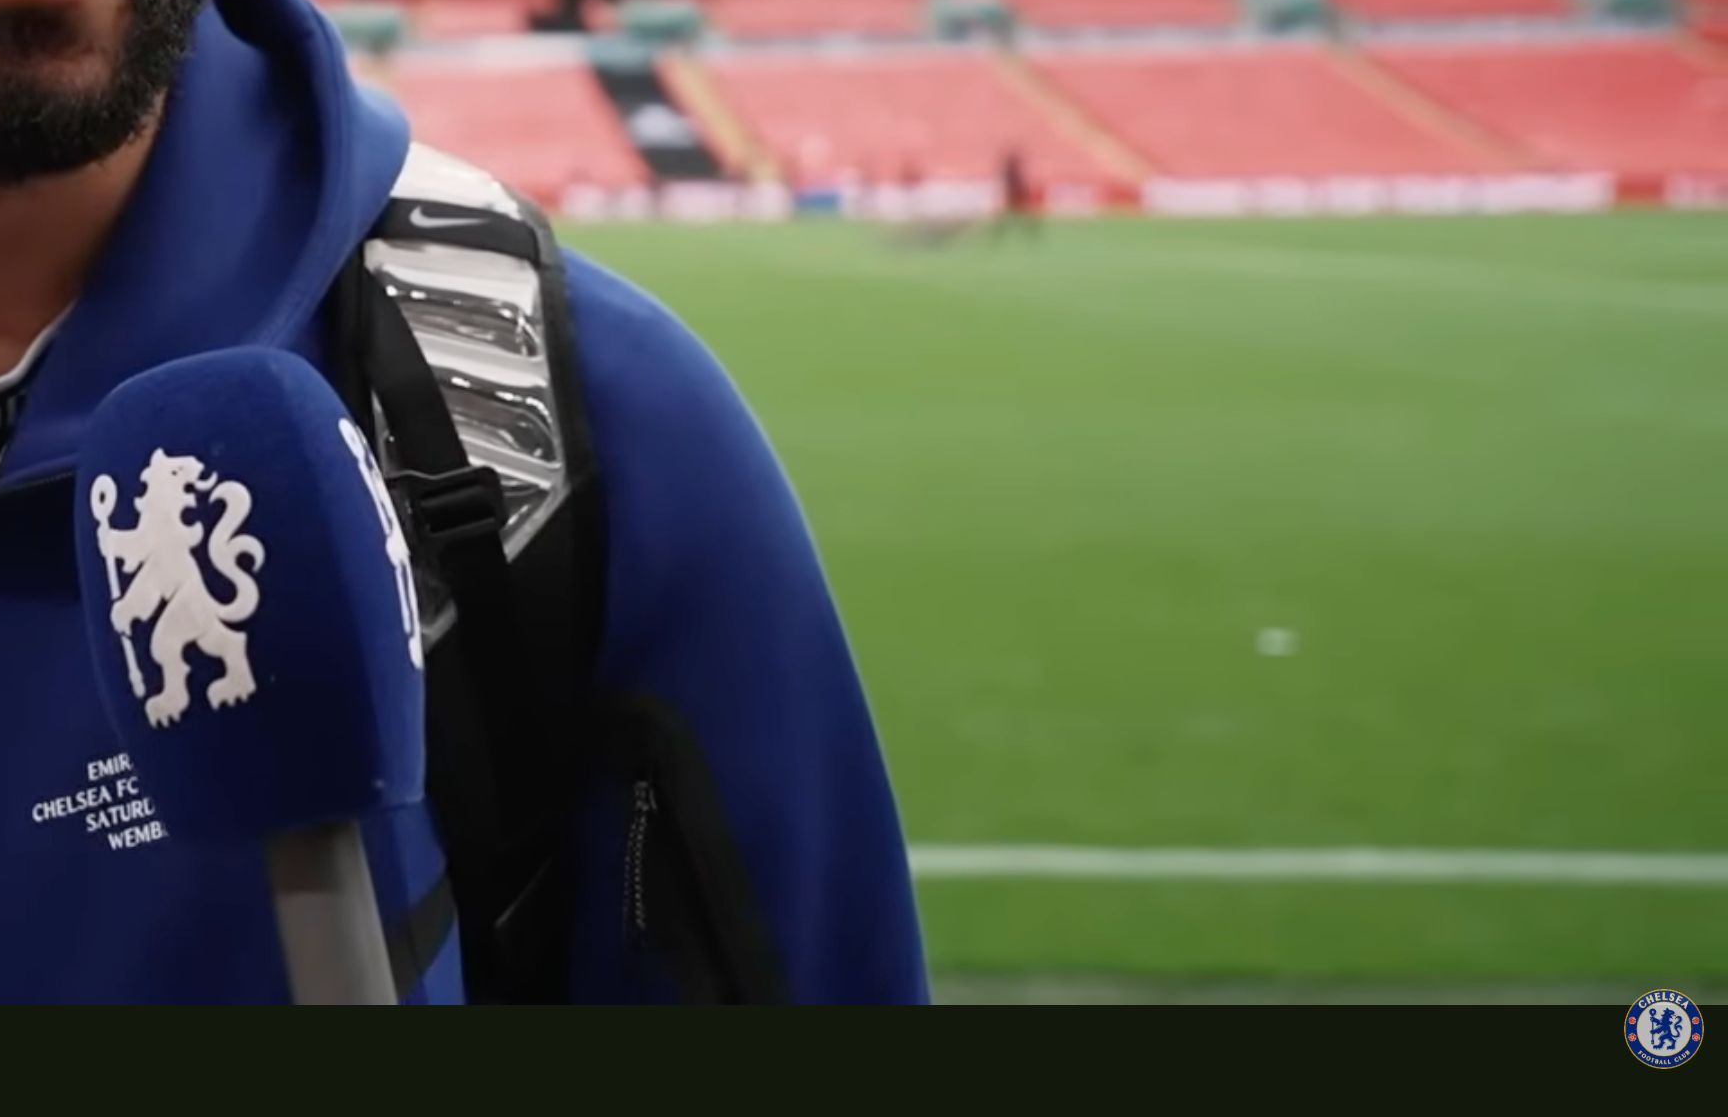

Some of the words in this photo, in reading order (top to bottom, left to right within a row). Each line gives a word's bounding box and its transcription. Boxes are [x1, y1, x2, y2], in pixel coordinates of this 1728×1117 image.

[86, 751, 134, 782] EMIR
[31, 784, 113, 823] CHELSEA
[115, 775, 140, 799] FC
[106, 819, 170, 851] WEMB
